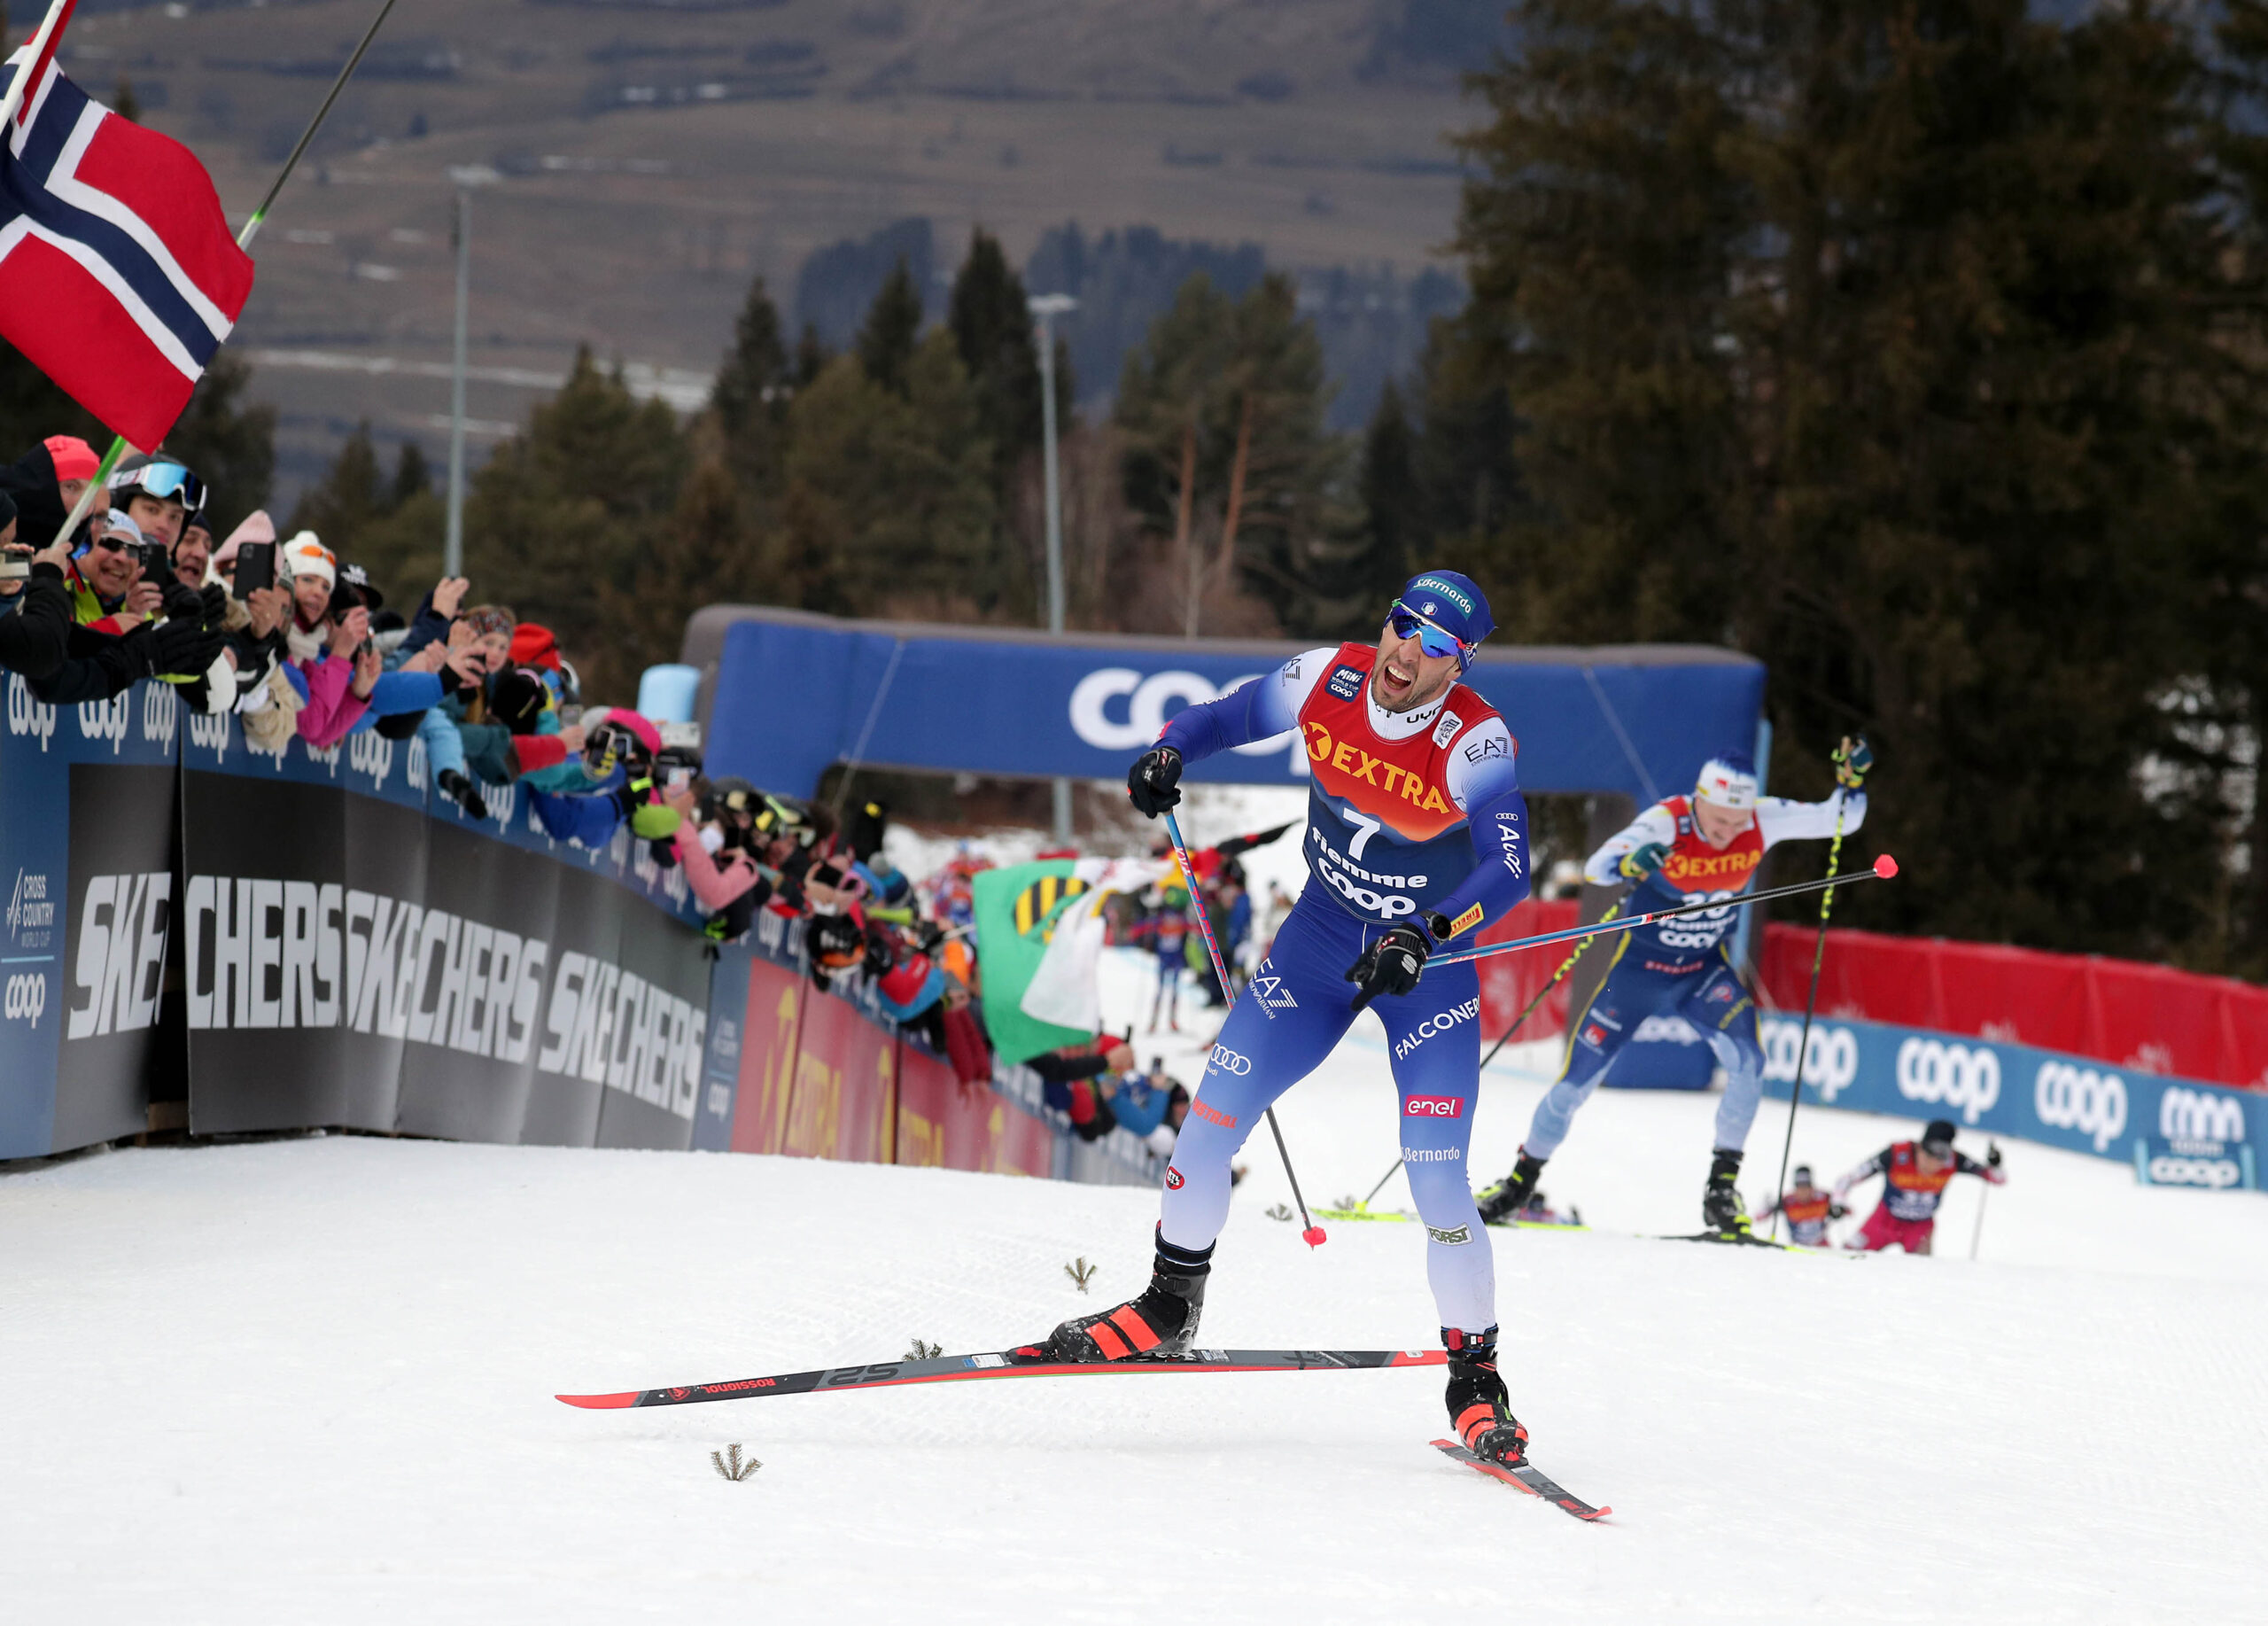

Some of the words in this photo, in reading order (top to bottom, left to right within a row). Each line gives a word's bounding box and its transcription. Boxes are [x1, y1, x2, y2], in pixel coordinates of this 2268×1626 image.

[144, 680, 176, 756] coop
[1331, 684, 1353, 697] coop
[1332, 741, 1450, 814] EXTRA
[1342, 807, 1380, 861] 7
[1497, 824, 1522, 880] Audi
[24, 875, 47, 899] CROSS
[1317, 857, 1417, 920] coop
[1689, 850, 1761, 877] EXTRA
[22, 902, 55, 928] COUNTRY
[4, 973, 46, 1029] coop
[346, 889, 548, 1063] SKECHERS
[539, 950, 707, 1120] SKECHERS
[1394, 994, 1480, 1061] FALCONER
[1409, 1100, 1456, 1115] enel
[1896, 1037, 2000, 1124] coop
[2035, 1061, 2128, 1151] coop
[2149, 1156, 2241, 1189] coop
[1428, 1226, 1468, 1243] FORST
[701, 1378, 776, 1394] ROSSIGNOL
